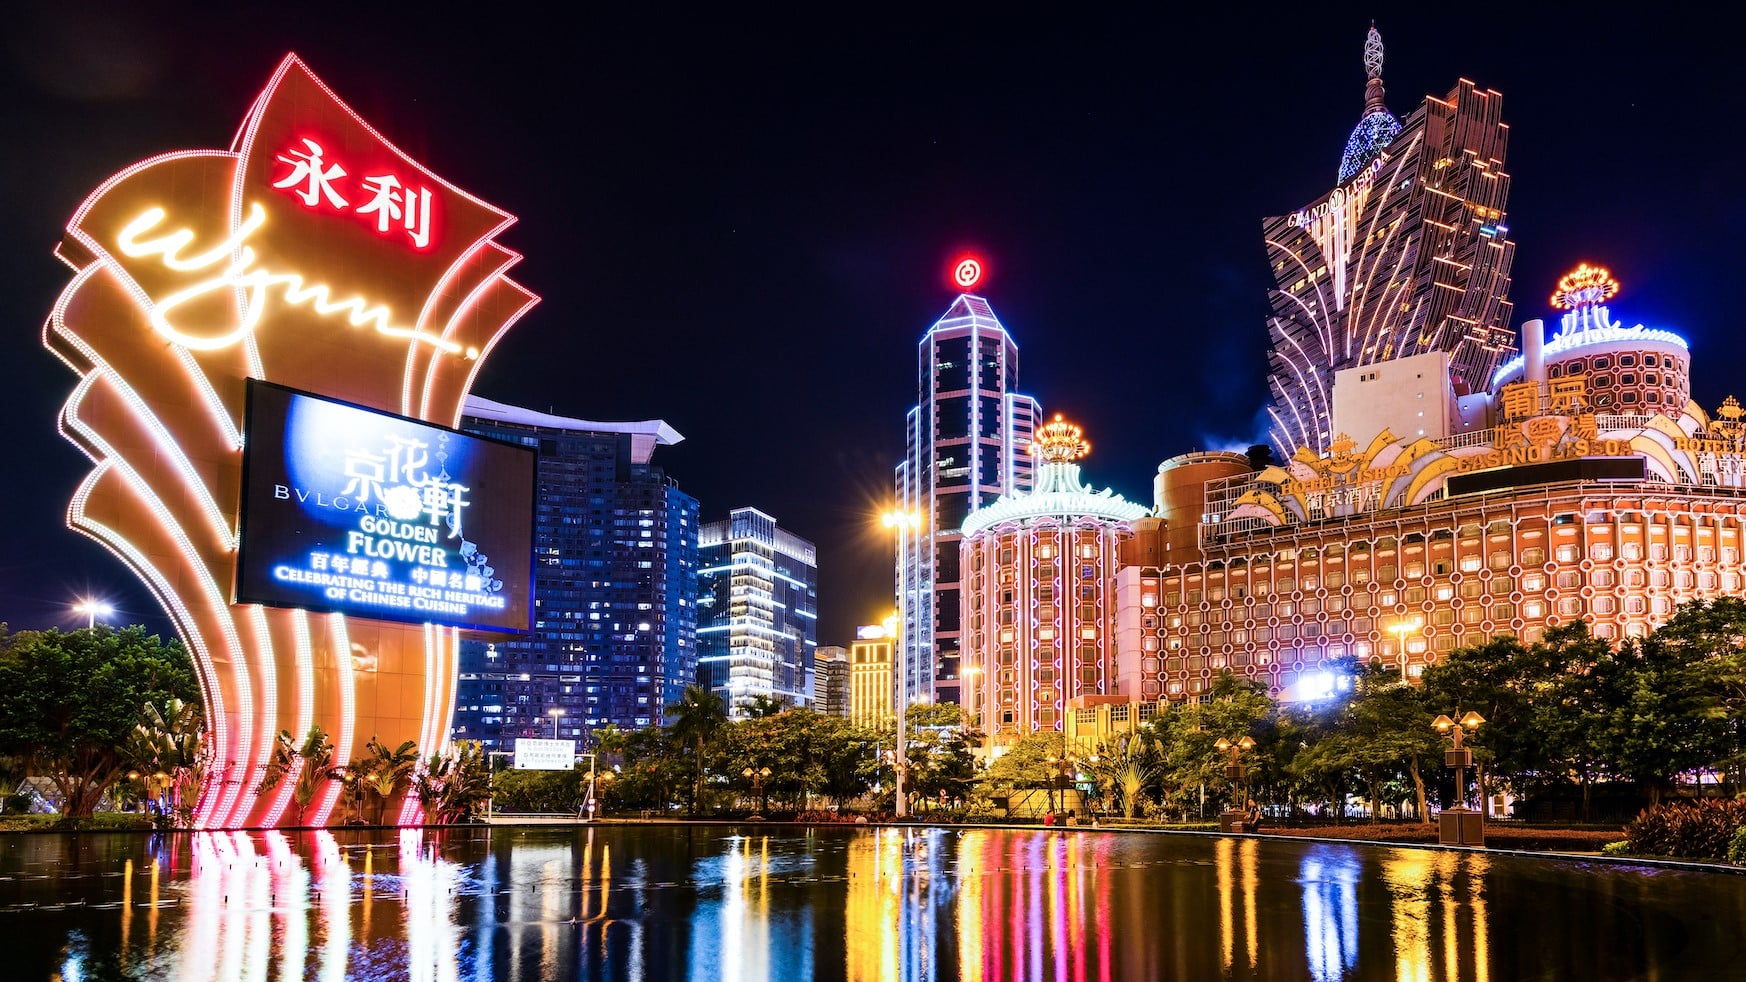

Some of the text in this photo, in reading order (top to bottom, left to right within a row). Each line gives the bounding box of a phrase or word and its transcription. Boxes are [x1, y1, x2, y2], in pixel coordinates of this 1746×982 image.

[272, 138, 433, 249] 永利
[1287, 151, 1392, 228] GRAND LISBOA
[1500, 375, 1589, 419] 葡京
[1456, 439, 1634, 473] CASINO LISBOA
[1675, 437, 1733, 454] HOTEL
[1281, 464, 1412, 496] HOTEL LISBOA
[1304, 483, 1383, 511] 葡京酒店
[274, 484, 389, 518] BVLGAR
[360, 515, 438, 545] GOLDEN
[347, 531, 447, 568] FLOWER
[274, 565, 505, 608] CELEBRATING THE RICH HERITAGE
[412, 567, 481, 592] 中國名
[326, 586, 467, 615] OF CHINESE CUISINE
